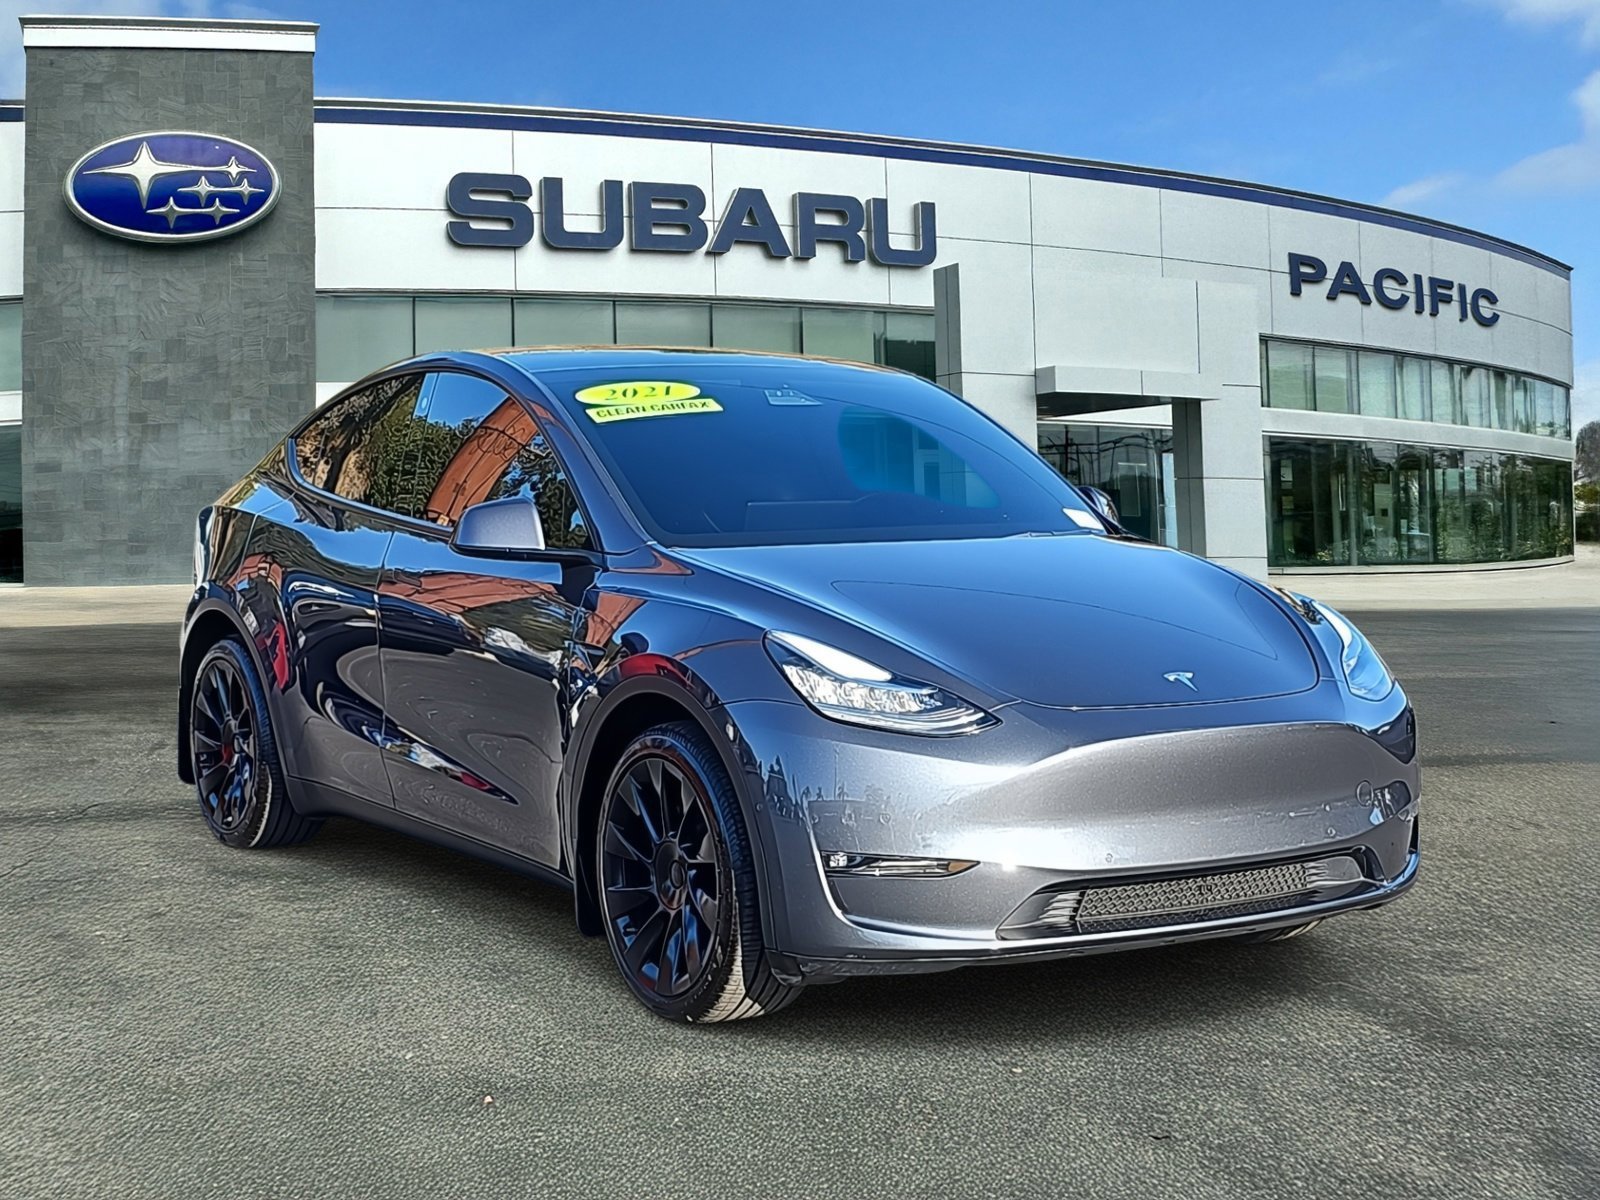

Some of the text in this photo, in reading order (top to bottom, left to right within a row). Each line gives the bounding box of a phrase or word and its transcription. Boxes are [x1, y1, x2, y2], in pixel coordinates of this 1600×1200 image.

[446, 172, 938, 267] SUBARU
[1287, 252, 1501, 328] PACIFIC
[596, 400, 710, 418] CLEAN CARFAX
[604, 385, 672, 401] 2021
